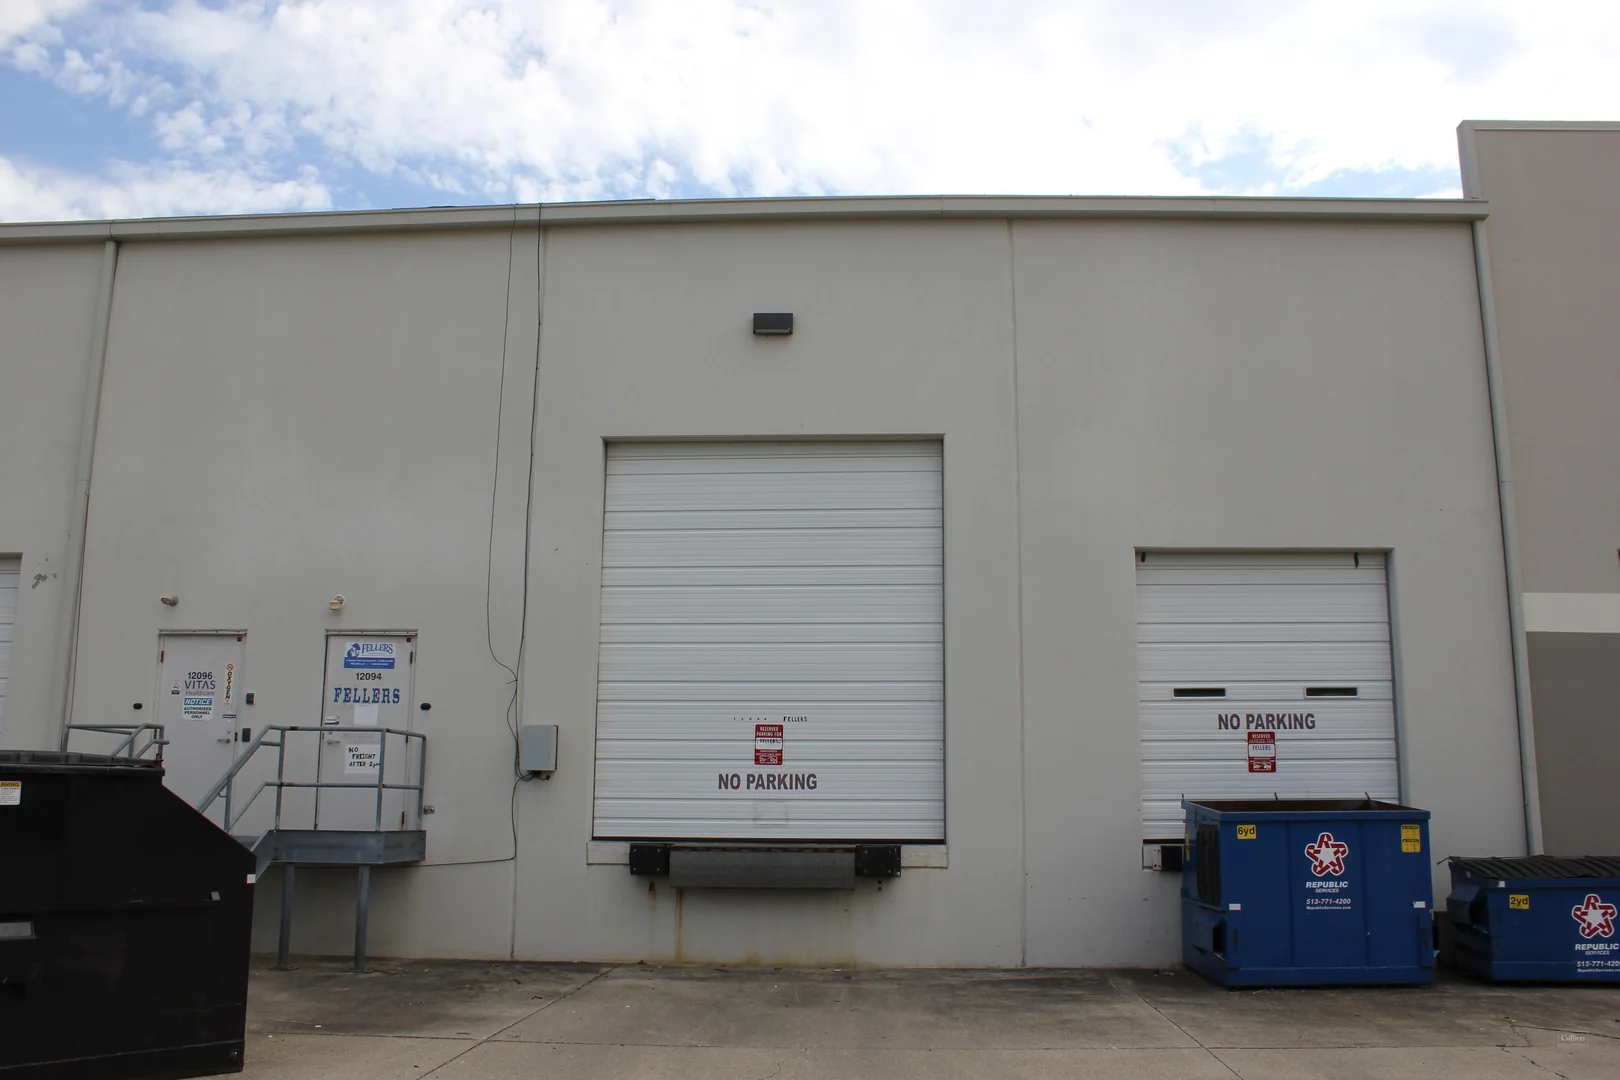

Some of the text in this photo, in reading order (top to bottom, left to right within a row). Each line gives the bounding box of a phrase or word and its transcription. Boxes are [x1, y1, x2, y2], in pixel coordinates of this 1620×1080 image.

[361, 643, 394, 654] FELLERS
[188, 672, 212, 680] 12096
[355, 672, 382, 680] 12094
[184, 680, 216, 690] VITAS
[333, 687, 400, 704] FELLERS
[1217, 713, 1316, 730] NO PARKING
[718, 773, 818, 790] NO PARKING
[1237, 826, 1256, 837] 6yd
[1510, 896, 1529, 907] 2yd
